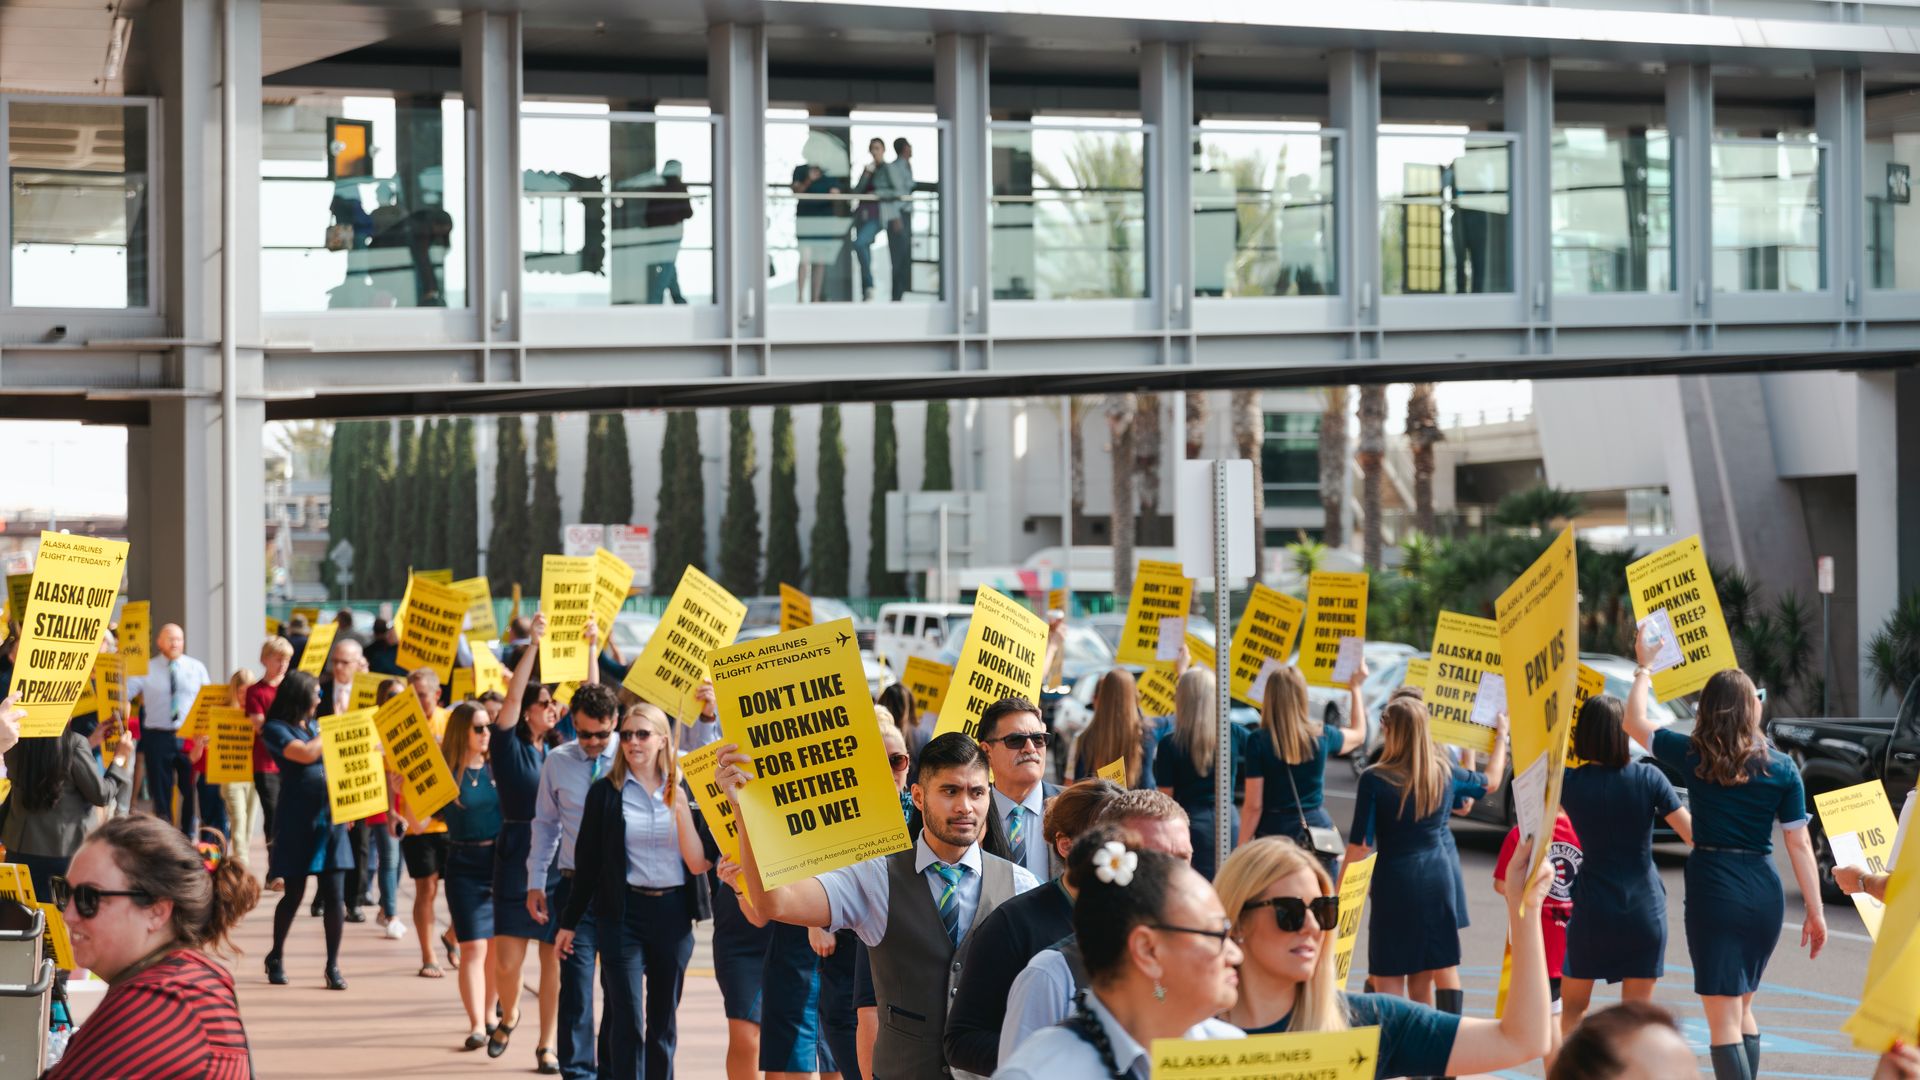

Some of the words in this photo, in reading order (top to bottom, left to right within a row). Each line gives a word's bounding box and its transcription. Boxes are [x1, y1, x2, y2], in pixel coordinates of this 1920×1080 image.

[43, 540, 71, 551] ALASKA
[73, 543, 103, 555] AIRLINES
[40, 551, 66, 562] FLIGHT
[67, 556, 111, 568] ATTENDANTS
[34, 581, 84, 606] ALASKA
[86, 587, 114, 608] QUIT
[554, 583, 577, 594] DON'T
[1143, 582, 1166, 593] DON'T
[1168, 585, 1184, 596] LIKE
[1643, 577, 1671, 602] DON'T
[1674, 568, 1697, 587] LIKE
[554, 599, 589, 610] WORKING
[978, 601, 1001, 617] FLIGHT
[980, 591, 1005, 609] ALASKA
[1142, 597, 1181, 610] WORKING
[1318, 596, 1341, 607] DON'T
[1343, 598, 1358, 609] LIKE
[34, 612, 101, 642] STALLING
[409, 613, 455, 637] STALLING
[550, 615, 564, 626] FOR
[683, 598, 709, 619] DON'T
[709, 616, 728, 637] LIKE
[1254, 609, 1276, 626] DON'T
[1276, 619, 1291, 633] LIKE
[1318, 612, 1356, 624] WORKING
[1674, 605, 1706, 628] FREE?
[551, 631, 579, 642] NEITHER
[677, 614, 720, 650] WORKING
[1138, 624, 1160, 637] NEIT
[1250, 624, 1285, 647] WORKING
[1315, 627, 1330, 638] FOR
[552, 647, 561, 658] DO
[667, 629, 687, 649] FOR
[687, 641, 708, 666] FREE
[712, 651, 755, 669] ALASKA
[758, 637, 808, 657] AIRLINES
[981, 625, 1015, 654] DON'T
[1015, 643, 1036, 668] LIKE
[1138, 638, 1150, 649] DO
[1243, 637, 1259, 651] FOR
[1315, 642, 1339, 654] NEITH
[1688, 645, 1711, 663] WE!
[30, 649, 57, 670] OUR
[57, 651, 78, 671] PAY
[76, 651, 89, 671] IS
[662, 648, 703, 680] NEITHER
[715, 665, 752, 682] FLIGHT
[755, 646, 831, 673] ATTENDANTS
[1240, 652, 1264, 669] NEITH
[1314, 657, 1327, 668] DO
[1437, 643, 1482, 663] ALASKA
[1485, 651, 1502, 667] QU
[1525, 646, 1548, 696] PAY
[1550, 629, 1565, 672] US
[655, 665, 672, 682] DO
[977, 648, 1032, 689] WORKING
[1236, 667, 1249, 680] DO
[1438, 662, 1483, 685] STALL
[16, 679, 82, 703] APPALLING
[969, 670, 992, 694] FOR
[738, 683, 796, 719] DON'T
[799, 673, 846, 702] LIKE
[1436, 684, 1459, 701] OUR
[1463, 690, 1477, 703] PA
[1545, 690, 1558, 733] OR
[335, 727, 371, 743] ALASKA
[386, 723, 405, 743] DON'T
[403, 712, 418, 731] LIKE
[747, 705, 850, 749] WORKING
[339, 743, 370, 758] MAKES
[392, 728, 423, 757] WORKING
[397, 756, 411, 771] FOR
[409, 742, 429, 764] FREE?
[683, 753, 708, 769] ALASKA
[754, 750, 795, 779] FOR
[797, 735, 858, 772] FREE?
[407, 758, 433, 783] NEITHER
[687, 763, 709, 777] FLIGHT
[338, 779, 352, 790] WE
[355, 773, 378, 787] CAN'T
[415, 782, 426, 796] DO
[772, 767, 858, 807] NEITHER
[336, 794, 361, 807] MAKE
[786, 807, 817, 836] DO
[817, 797, 861, 827] WE!
[1866, 827, 1885, 847] US
[765, 863, 799, 879] Association
[800, 860, 807, 869] of
[807, 855, 823, 866] Flight
[1160, 1054, 1231, 1069] ALASKA
[1237, 1048, 1312, 1066] AIRLINES
